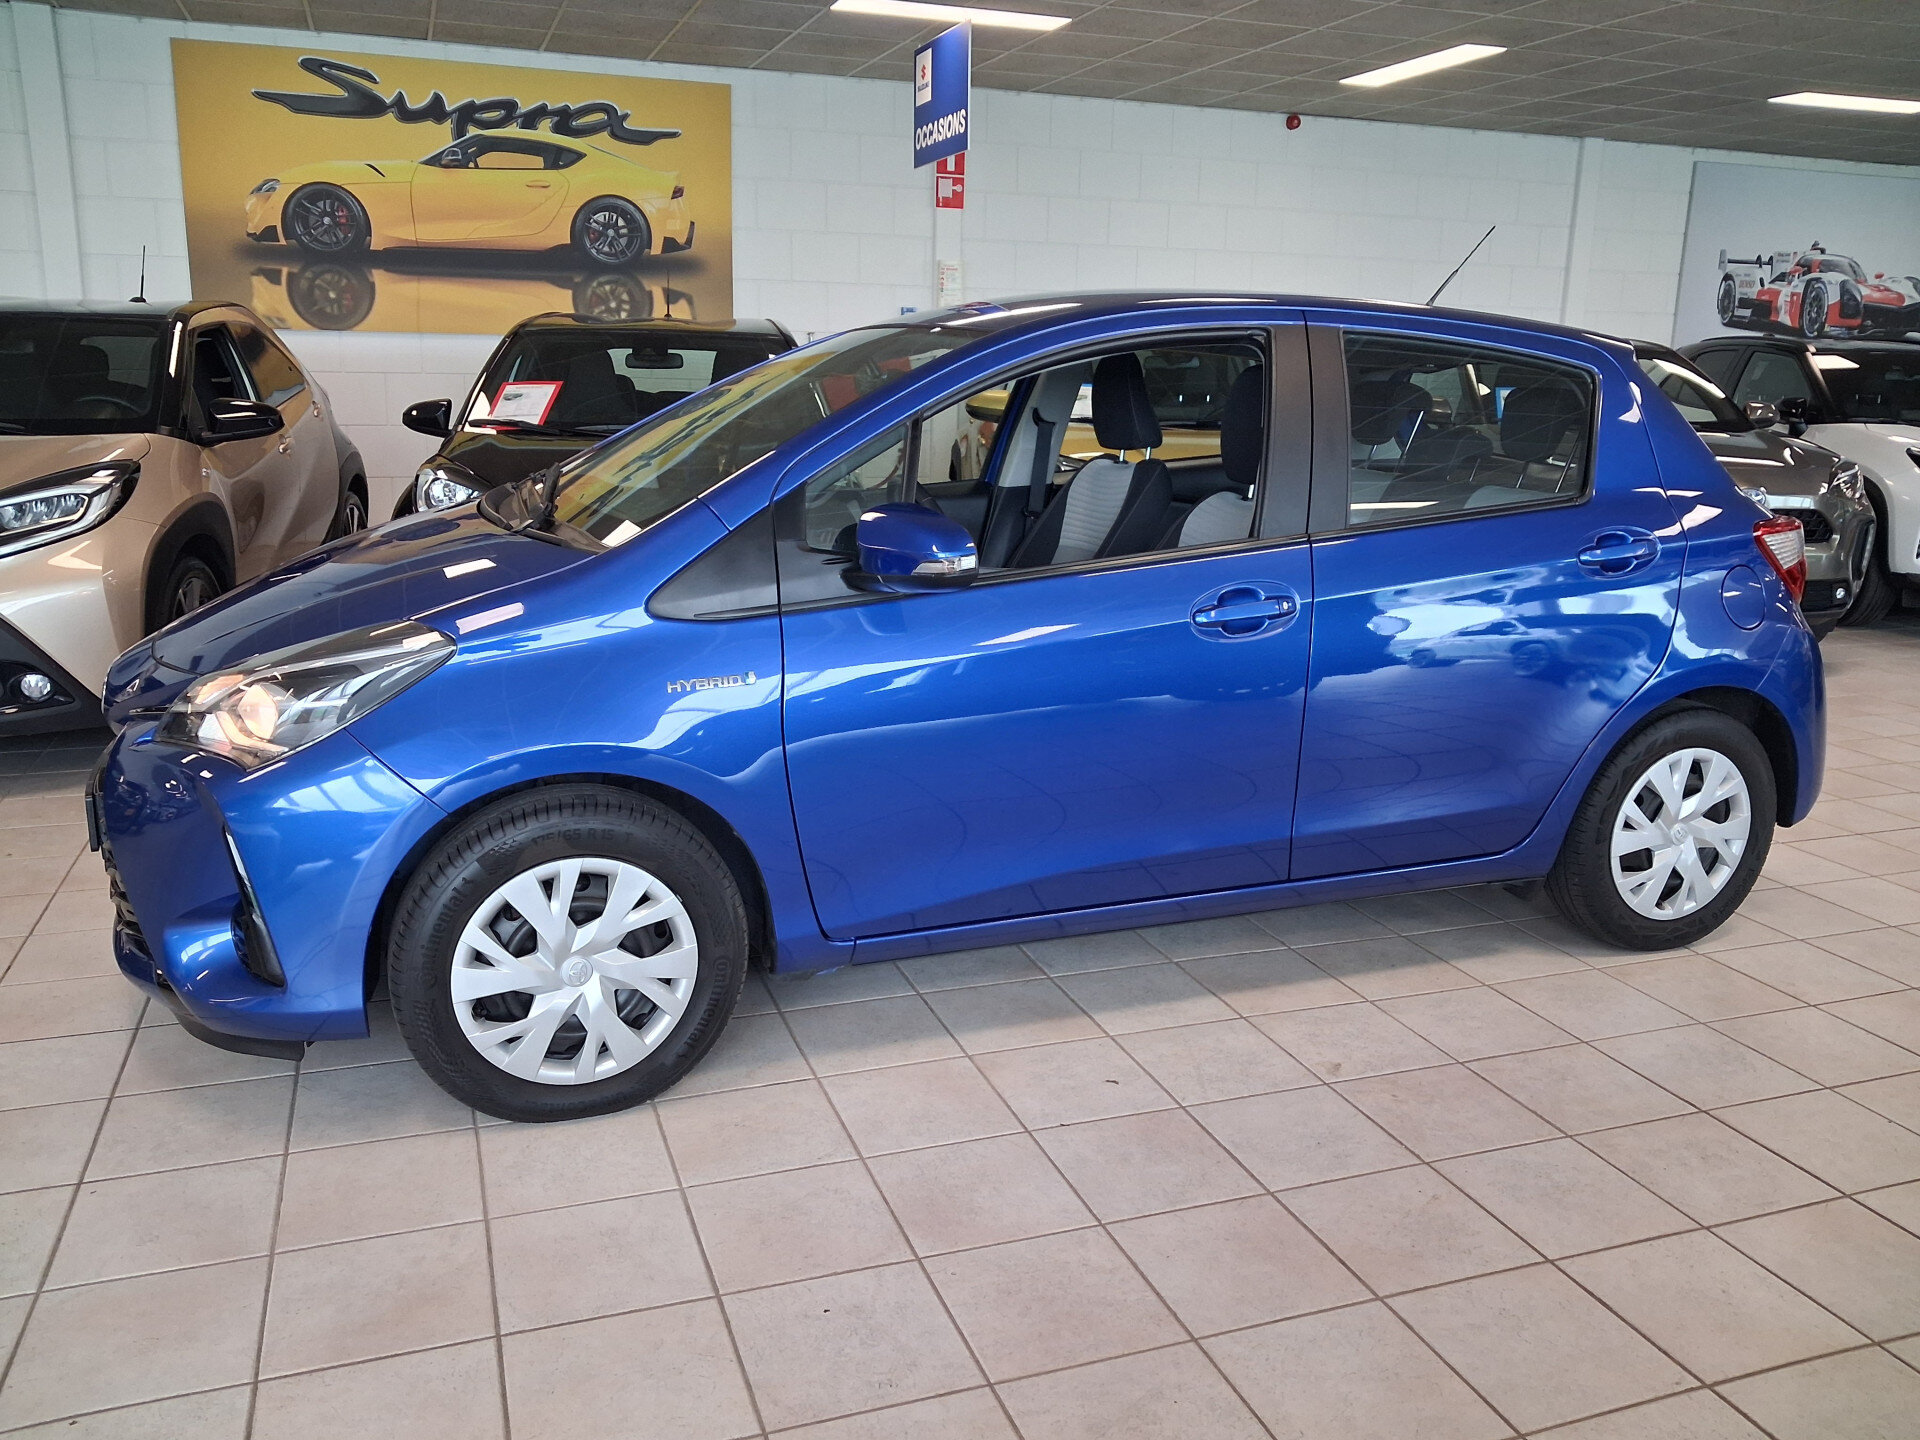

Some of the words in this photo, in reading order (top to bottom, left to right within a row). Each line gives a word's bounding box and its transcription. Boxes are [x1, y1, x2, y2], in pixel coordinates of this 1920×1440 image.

[251, 56, 682, 144] Supra
[915, 108, 967, 150] OCCASIONS
[667, 675, 744, 693] HYBRID
